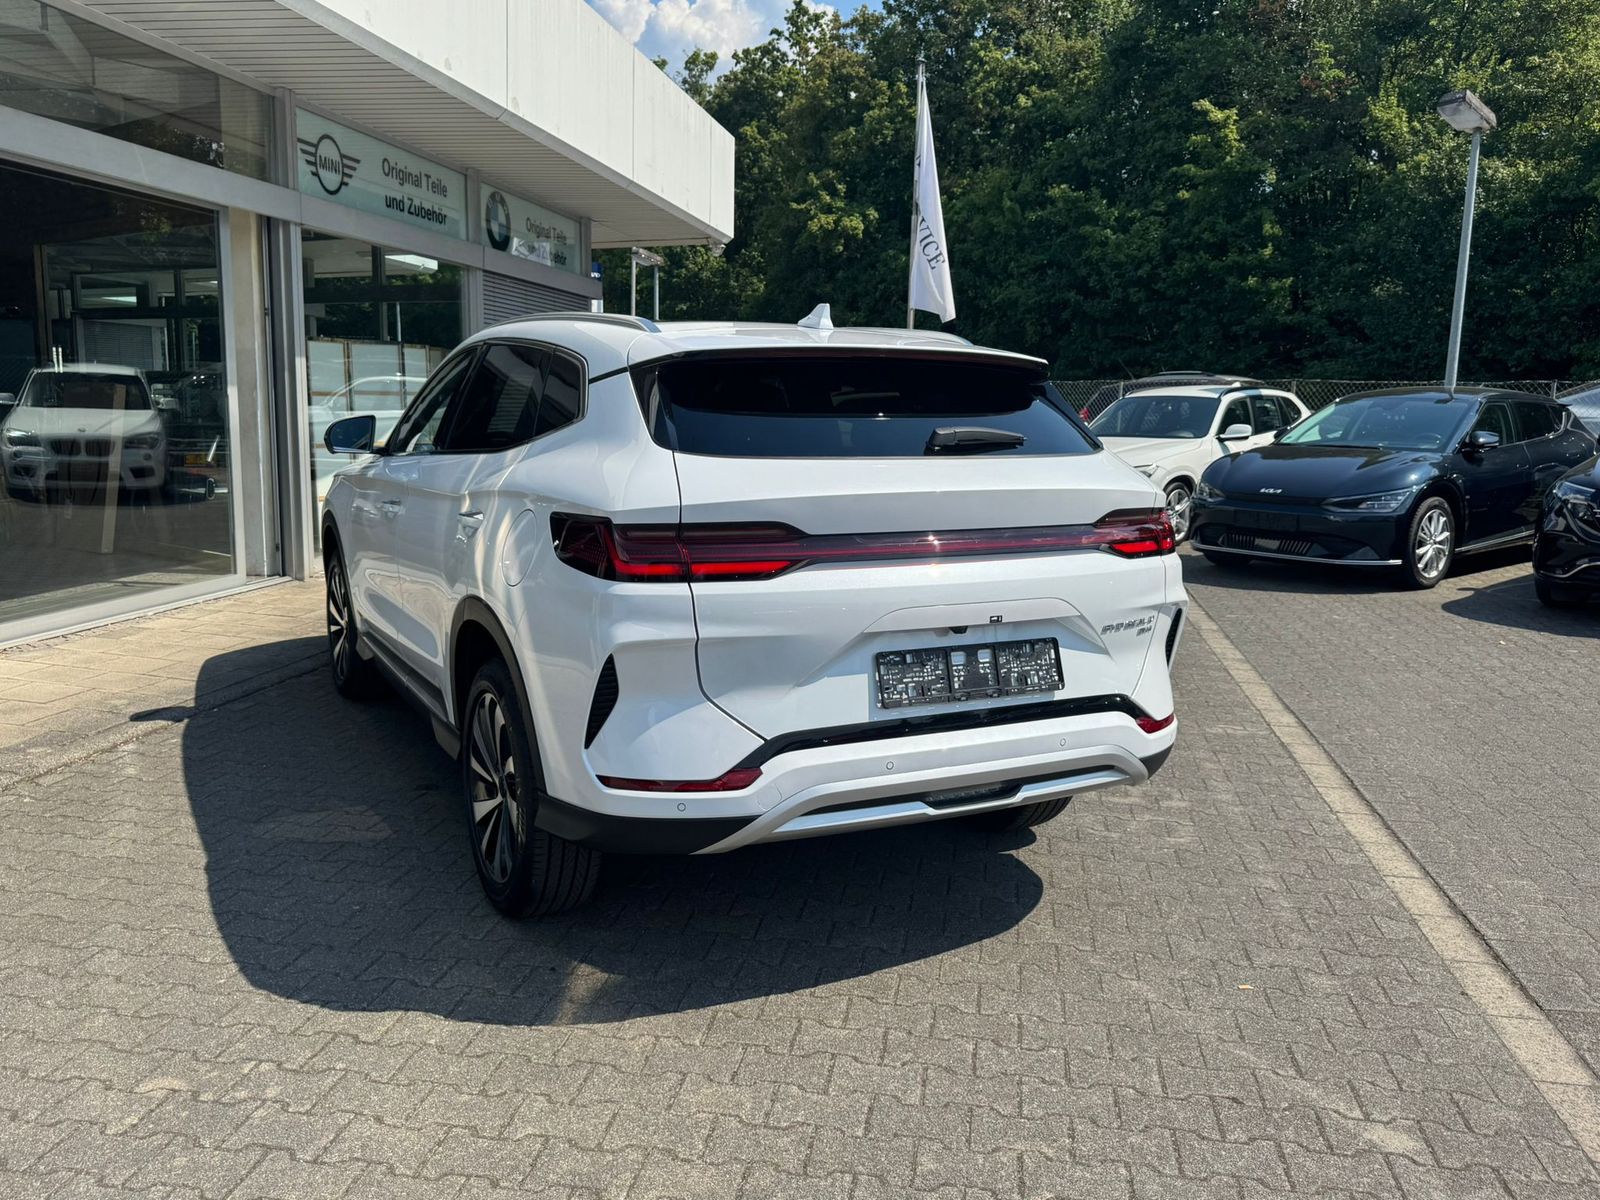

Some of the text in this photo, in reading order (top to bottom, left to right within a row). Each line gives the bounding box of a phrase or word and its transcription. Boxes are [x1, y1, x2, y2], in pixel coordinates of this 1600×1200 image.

[319, 155, 341, 175] MINI
[382, 157, 448, 198] Original Teile
[385, 194, 449, 226] und Zubehör
[525, 217, 551, 239] Original
